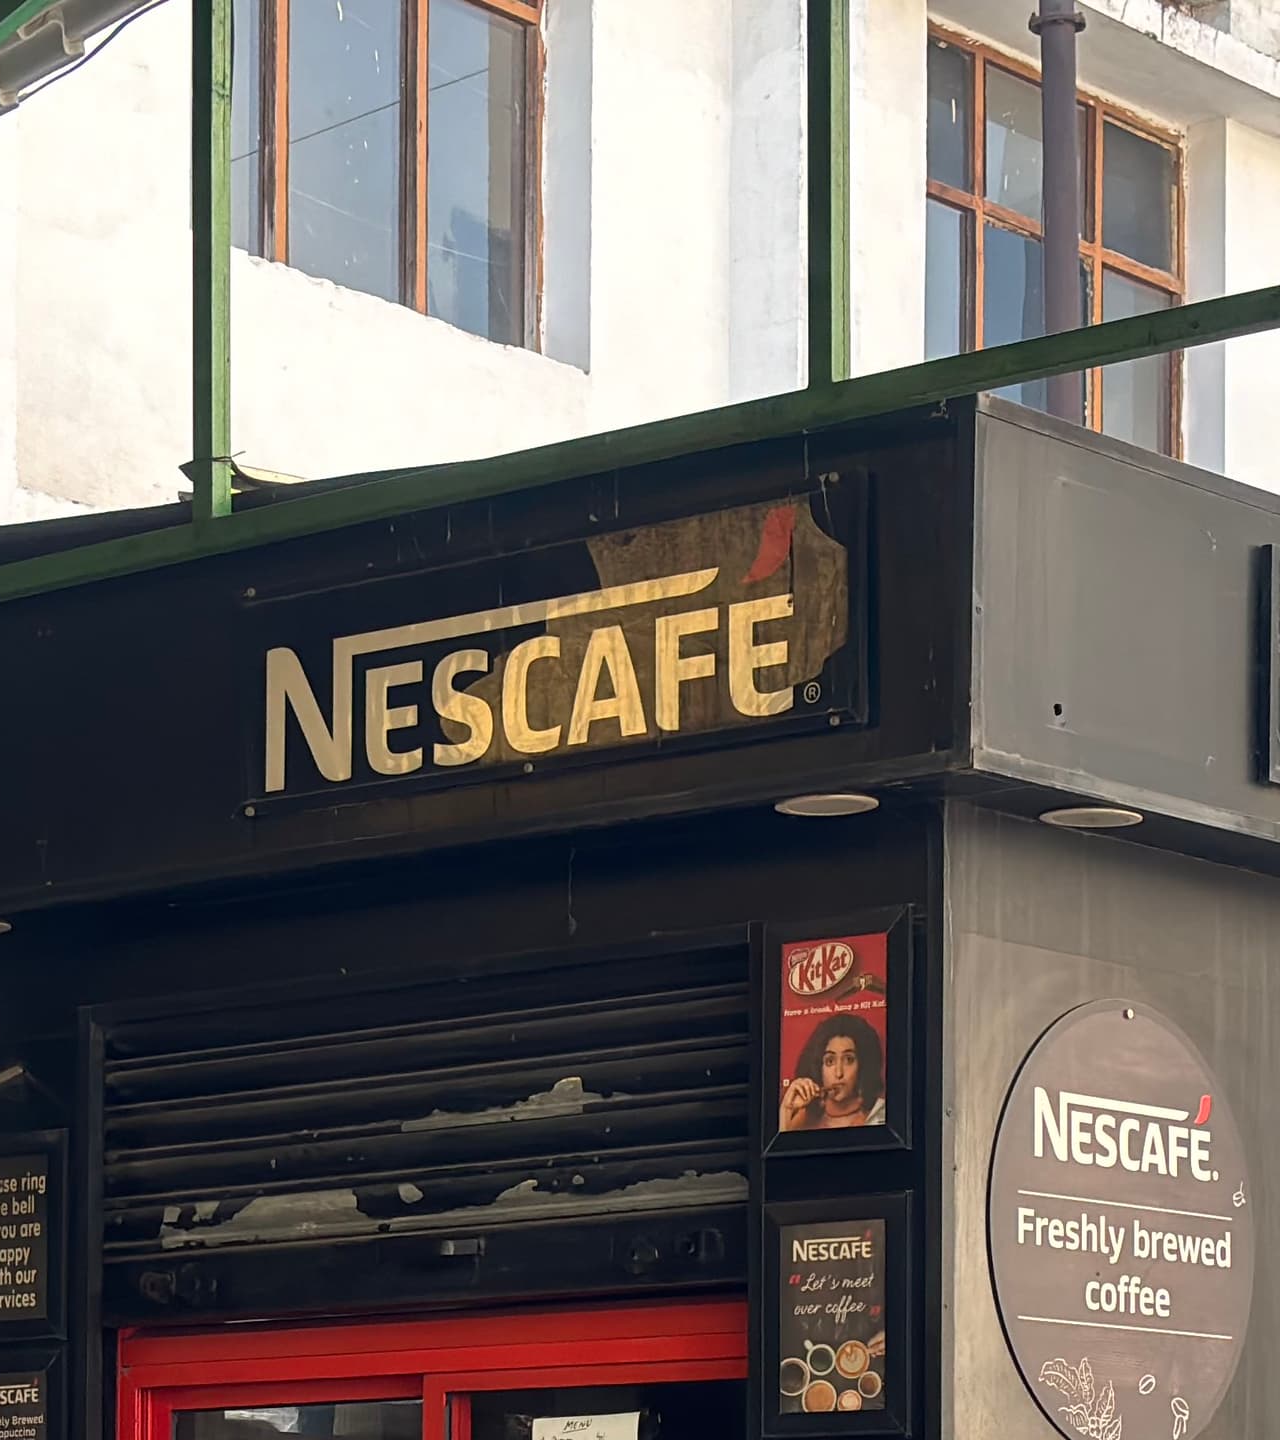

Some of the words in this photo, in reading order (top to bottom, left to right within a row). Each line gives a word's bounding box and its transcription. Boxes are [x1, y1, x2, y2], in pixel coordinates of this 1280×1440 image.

[21, 1172, 46, 1194] ring
[12, 1194, 35, 1215] bell
[20, 1223, 41, 1237] are
[1017, 1206, 1125, 1264] Freshly
[1132, 1219, 1231, 1268] brewed
[16, 1268, 37, 1285] our
[842, 1272, 874, 1288] meet
[1085, 1275, 1170, 1317] coffee
[794, 1303, 823, 1316] over
[12, 1414, 43, 1426] Brewed
[564, 1418, 592, 1431] MENU
